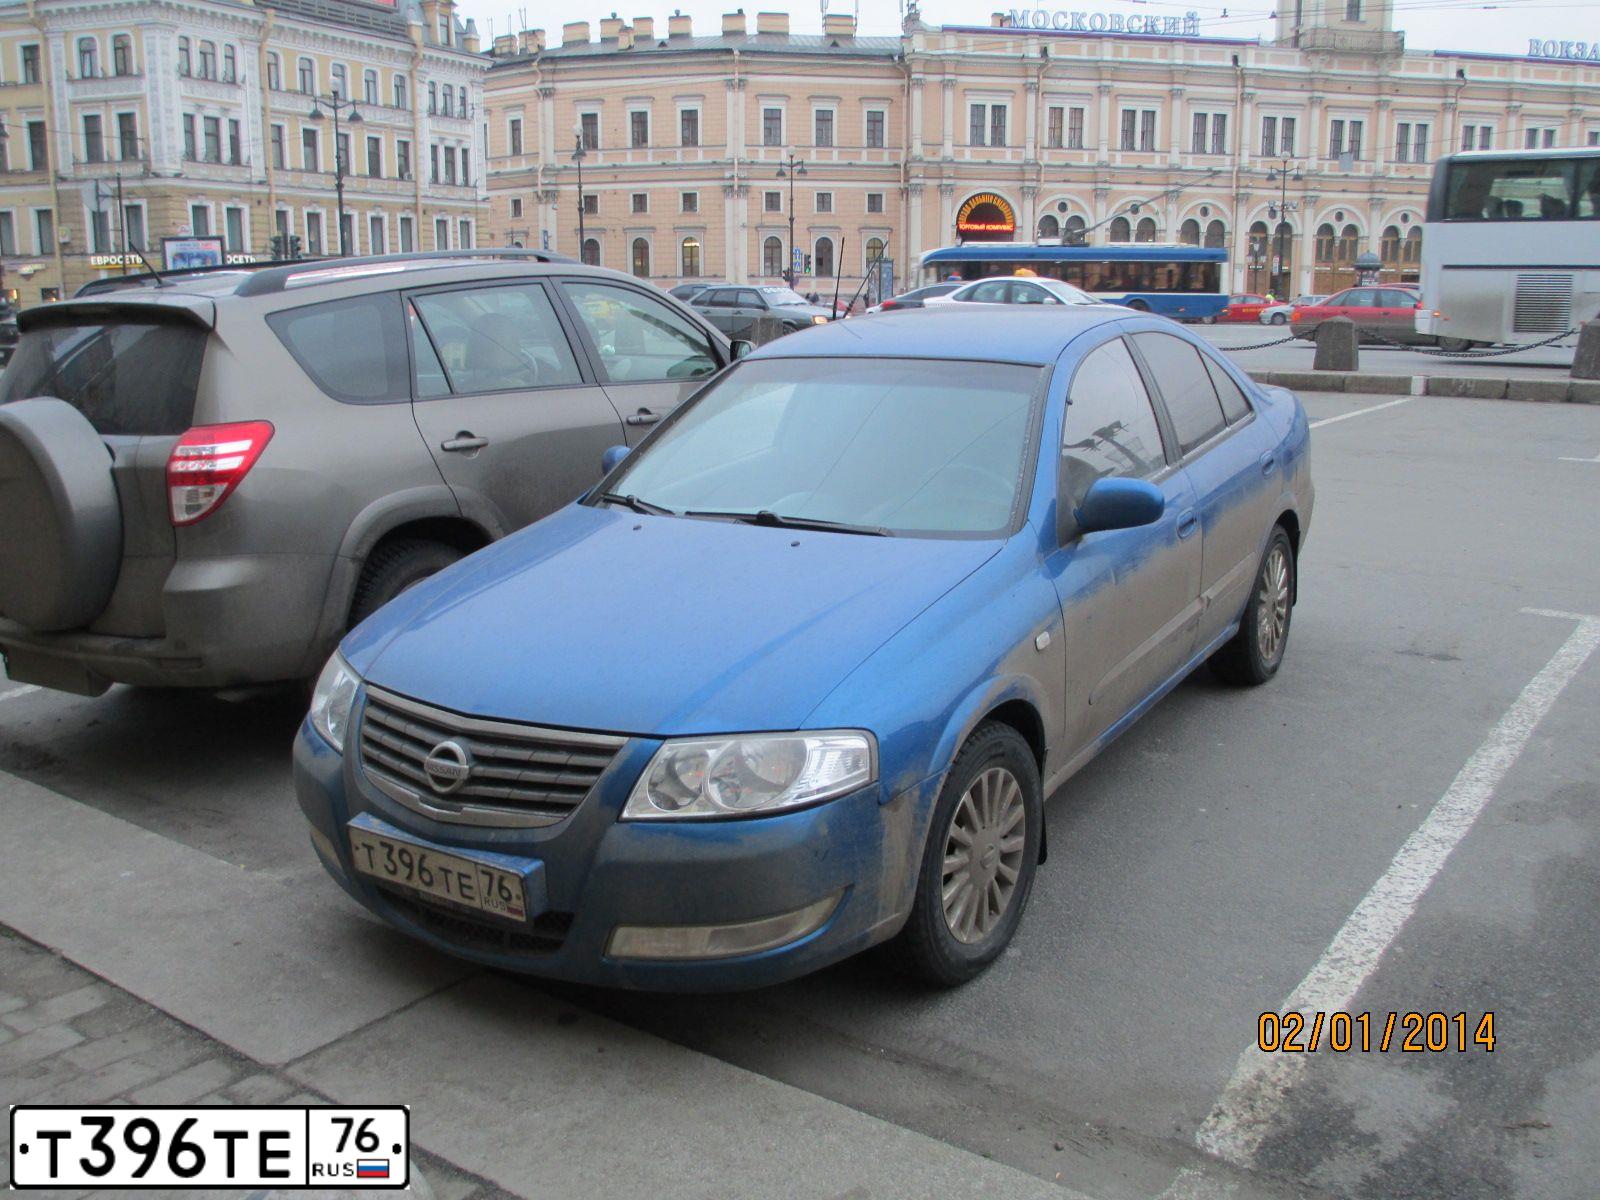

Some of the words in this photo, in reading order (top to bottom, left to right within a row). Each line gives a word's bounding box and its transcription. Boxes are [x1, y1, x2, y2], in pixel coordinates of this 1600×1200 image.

[1009, 9, 1201, 36] МОСКОВСКИЙ
[90, 254, 143, 266] ЕВРОСЕТЬ
[480, 870, 513, 902] 76
[483, 897, 507, 912] RUS
